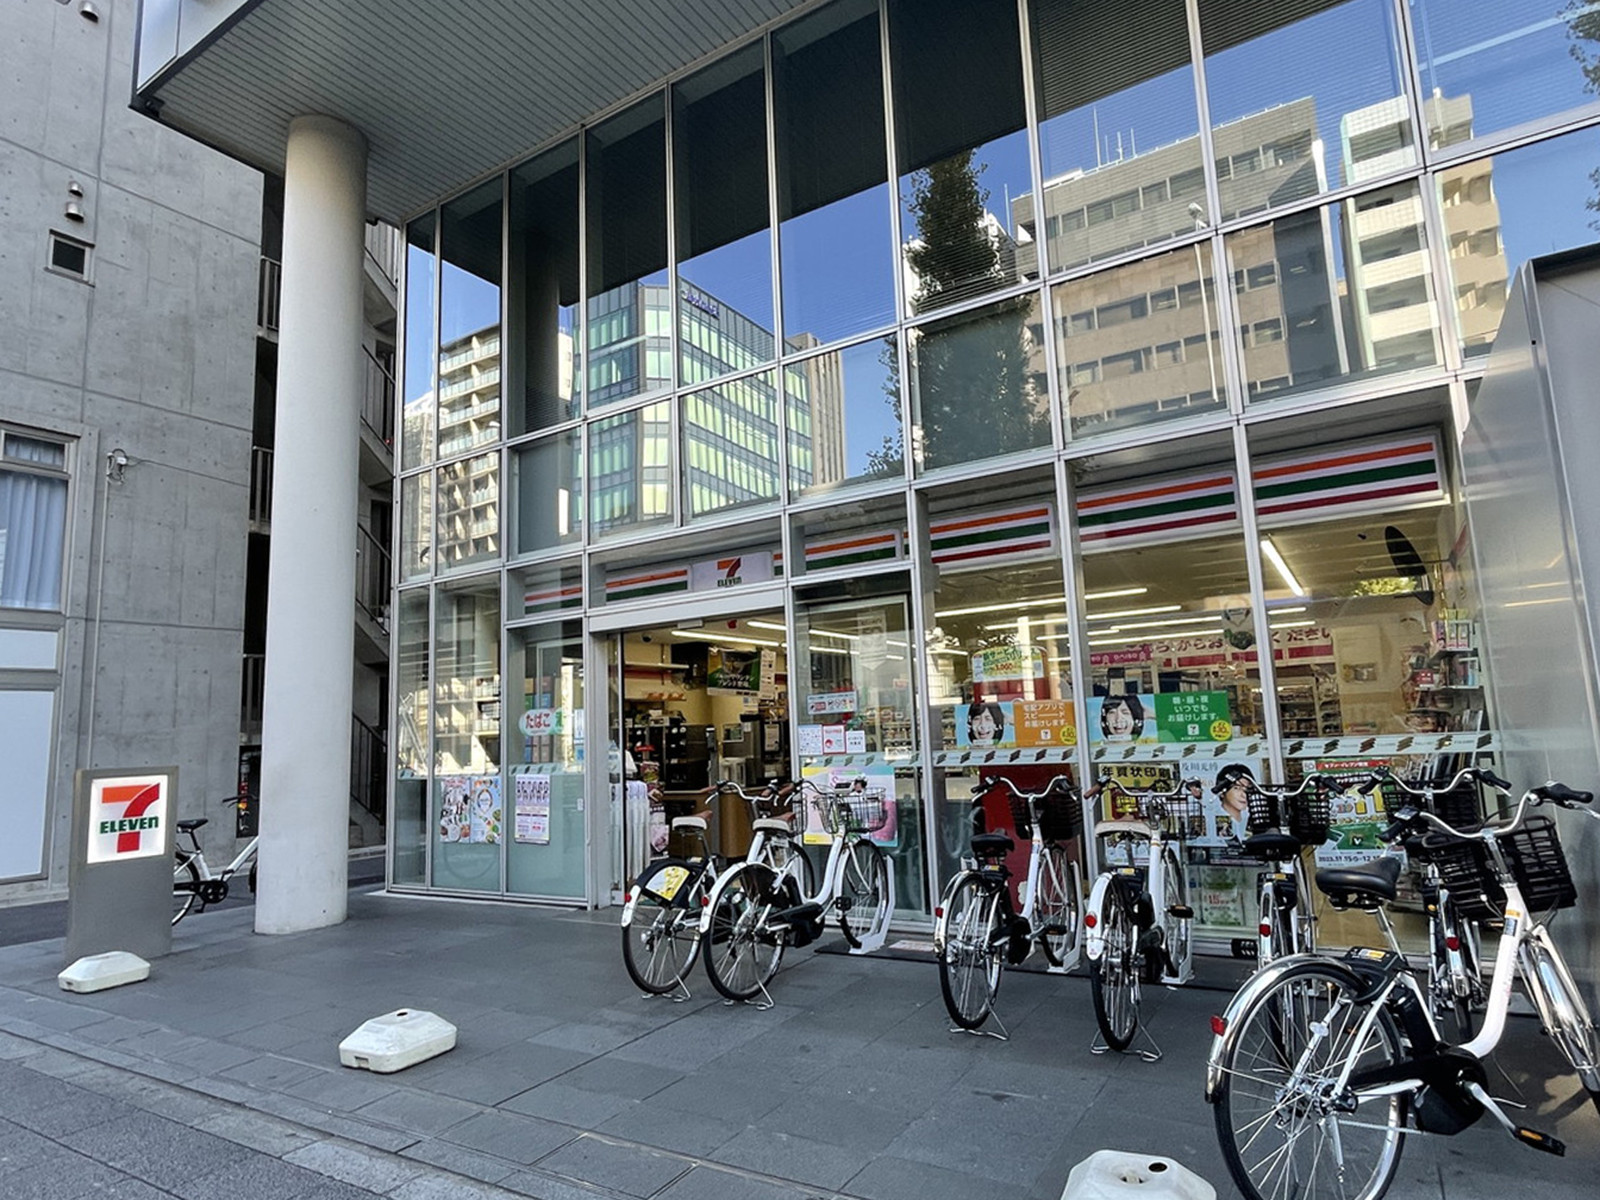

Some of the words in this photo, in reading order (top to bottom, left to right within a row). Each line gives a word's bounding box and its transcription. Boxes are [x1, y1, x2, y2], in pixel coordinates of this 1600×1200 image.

[1174, 704, 1209, 713] いつでも
[525, 713, 551, 729] たばこ
[1102, 765, 1172, 778] 年賀状印刷
